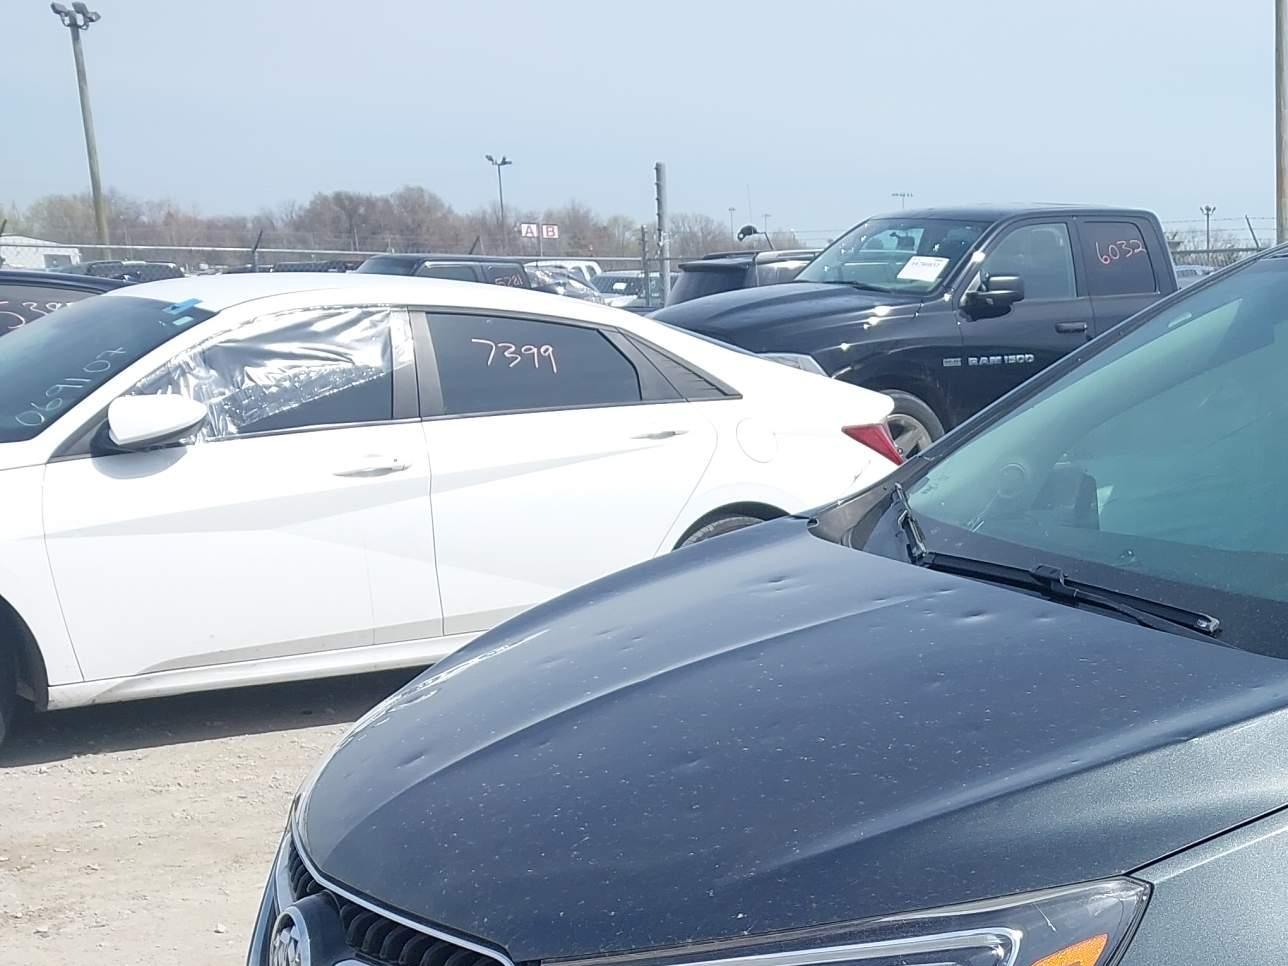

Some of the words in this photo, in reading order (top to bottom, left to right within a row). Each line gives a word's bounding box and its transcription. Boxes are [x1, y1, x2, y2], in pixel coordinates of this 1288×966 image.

[524, 223, 535, 236] A
[546, 225, 556, 236] B
[1095, 239, 1147, 264] 6032
[471, 338, 557, 374] 7399
[968, 357, 1002, 366] RAM
[1004, 354, 1034, 364] 1500
